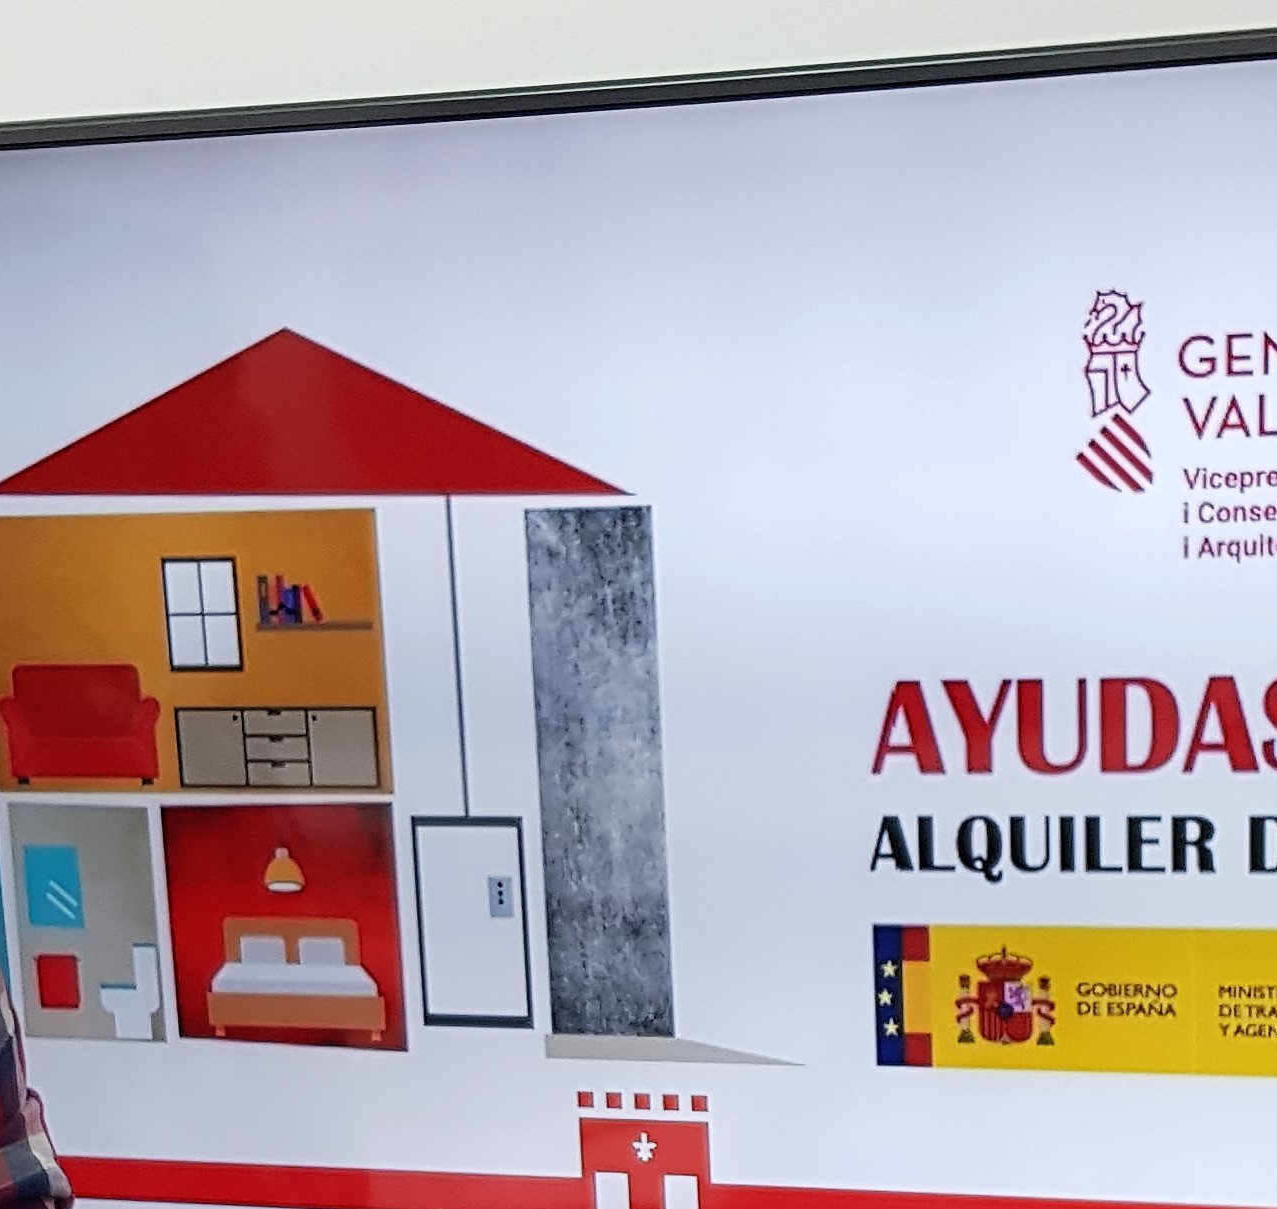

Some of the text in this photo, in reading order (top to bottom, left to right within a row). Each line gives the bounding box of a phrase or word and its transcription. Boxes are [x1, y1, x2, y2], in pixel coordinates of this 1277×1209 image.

[1183, 502, 1189, 523] i
[1183, 537, 1189, 559] i
[871, 815, 1215, 882] ALQUILER
[1076, 982, 1178, 999] GOBIERNO
[1077, 999, 1177, 1018] DE ESPAÑA
[1218, 1004, 1241, 1018] DE
[1220, 1023, 1230, 1037] Y
